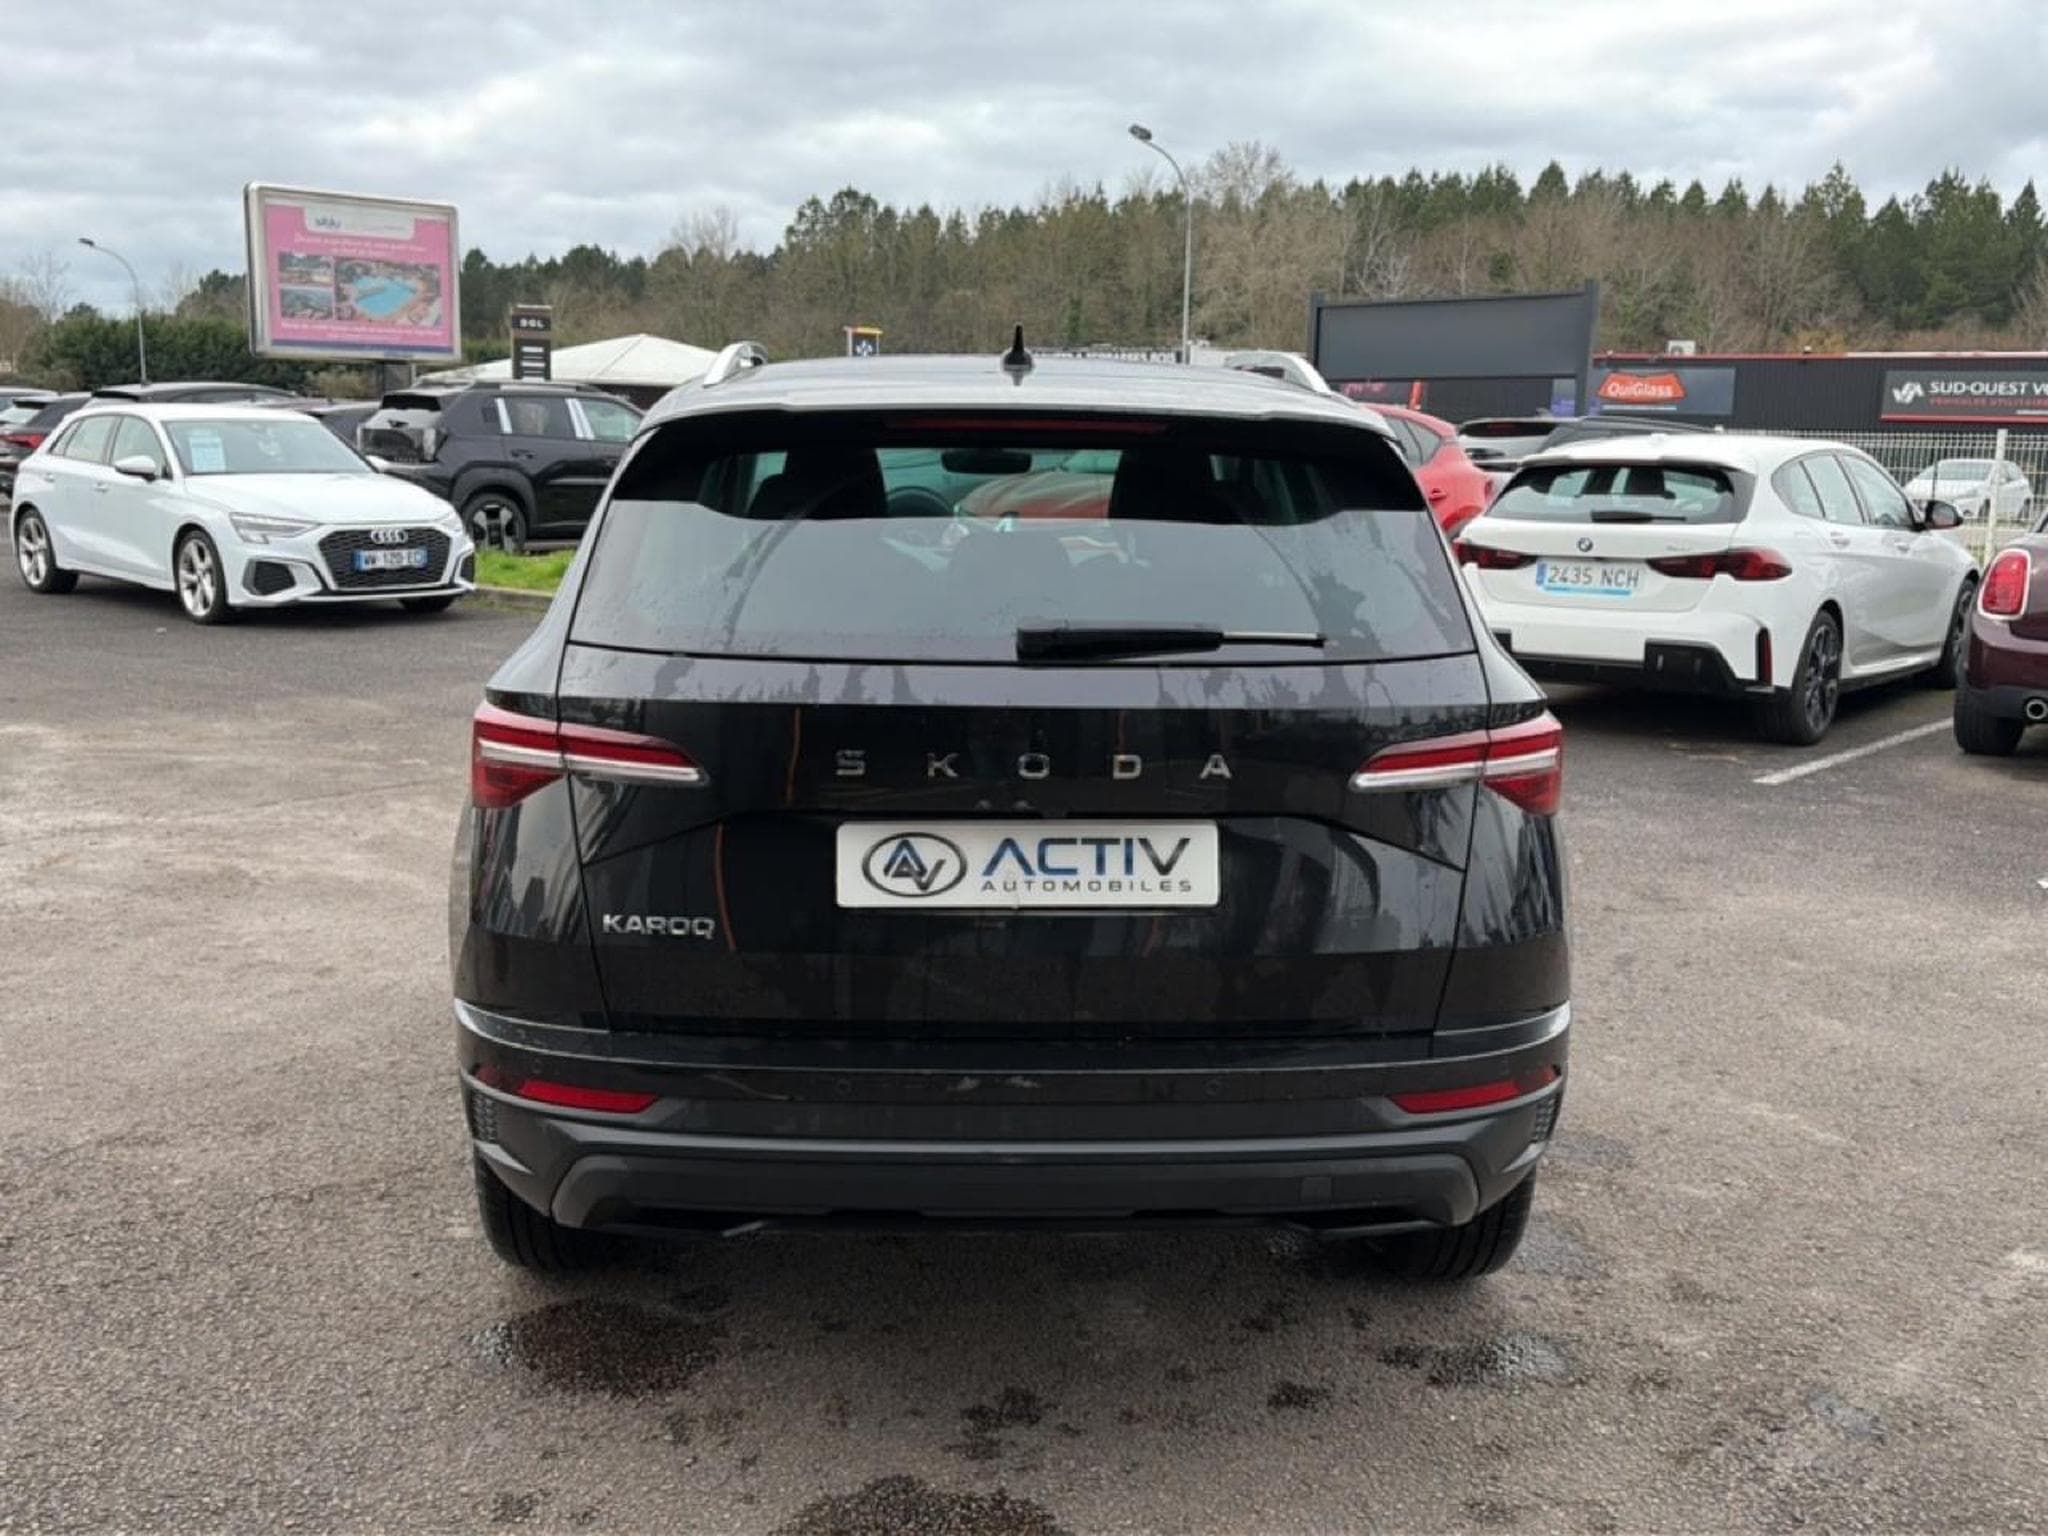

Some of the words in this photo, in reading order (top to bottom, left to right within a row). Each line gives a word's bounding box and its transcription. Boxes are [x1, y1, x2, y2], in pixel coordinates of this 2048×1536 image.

[1606, 381, 1675, 399] QuiGlass
[1928, 381, 2029, 396] SUD-OUEST
[1549, 566, 1593, 585] 2435
[1601, 568, 1640, 588] NCH
[981, 837, 1192, 876] ACTIV
[981, 879, 1193, 893] AUTOMOBILES
[602, 913, 716, 940] KAROQ
